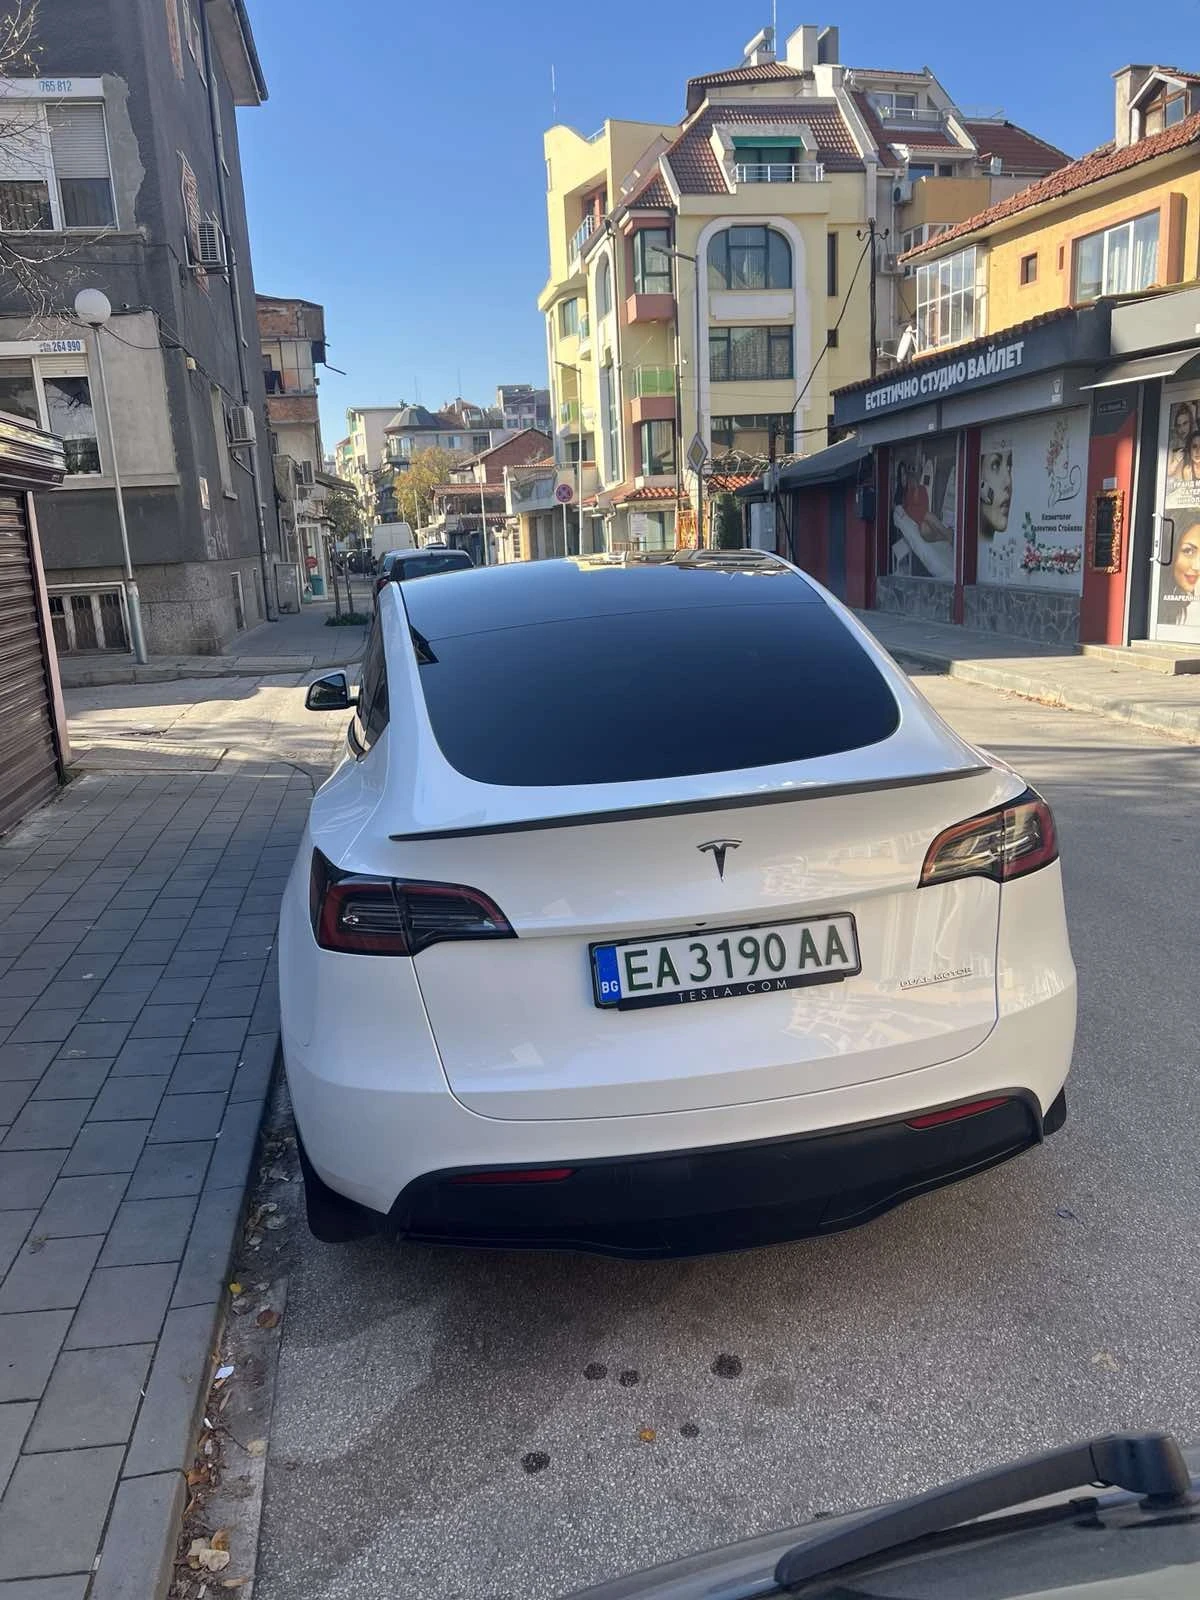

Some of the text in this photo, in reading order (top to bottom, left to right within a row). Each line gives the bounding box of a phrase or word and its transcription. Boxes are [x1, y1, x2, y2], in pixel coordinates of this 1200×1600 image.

[40, 80, 72, 92] 765 812
[52, 341, 66, 352] 264
[67, 340, 81, 351] 990
[865, 341, 1025, 411] ЕСТЕТИЧНО СТУДИО ВАЙЛЕТ
[600, 980, 619, 994] BG
[689, 931, 787, 982] 3190
[934, 966, 973, 981] MOTOR
